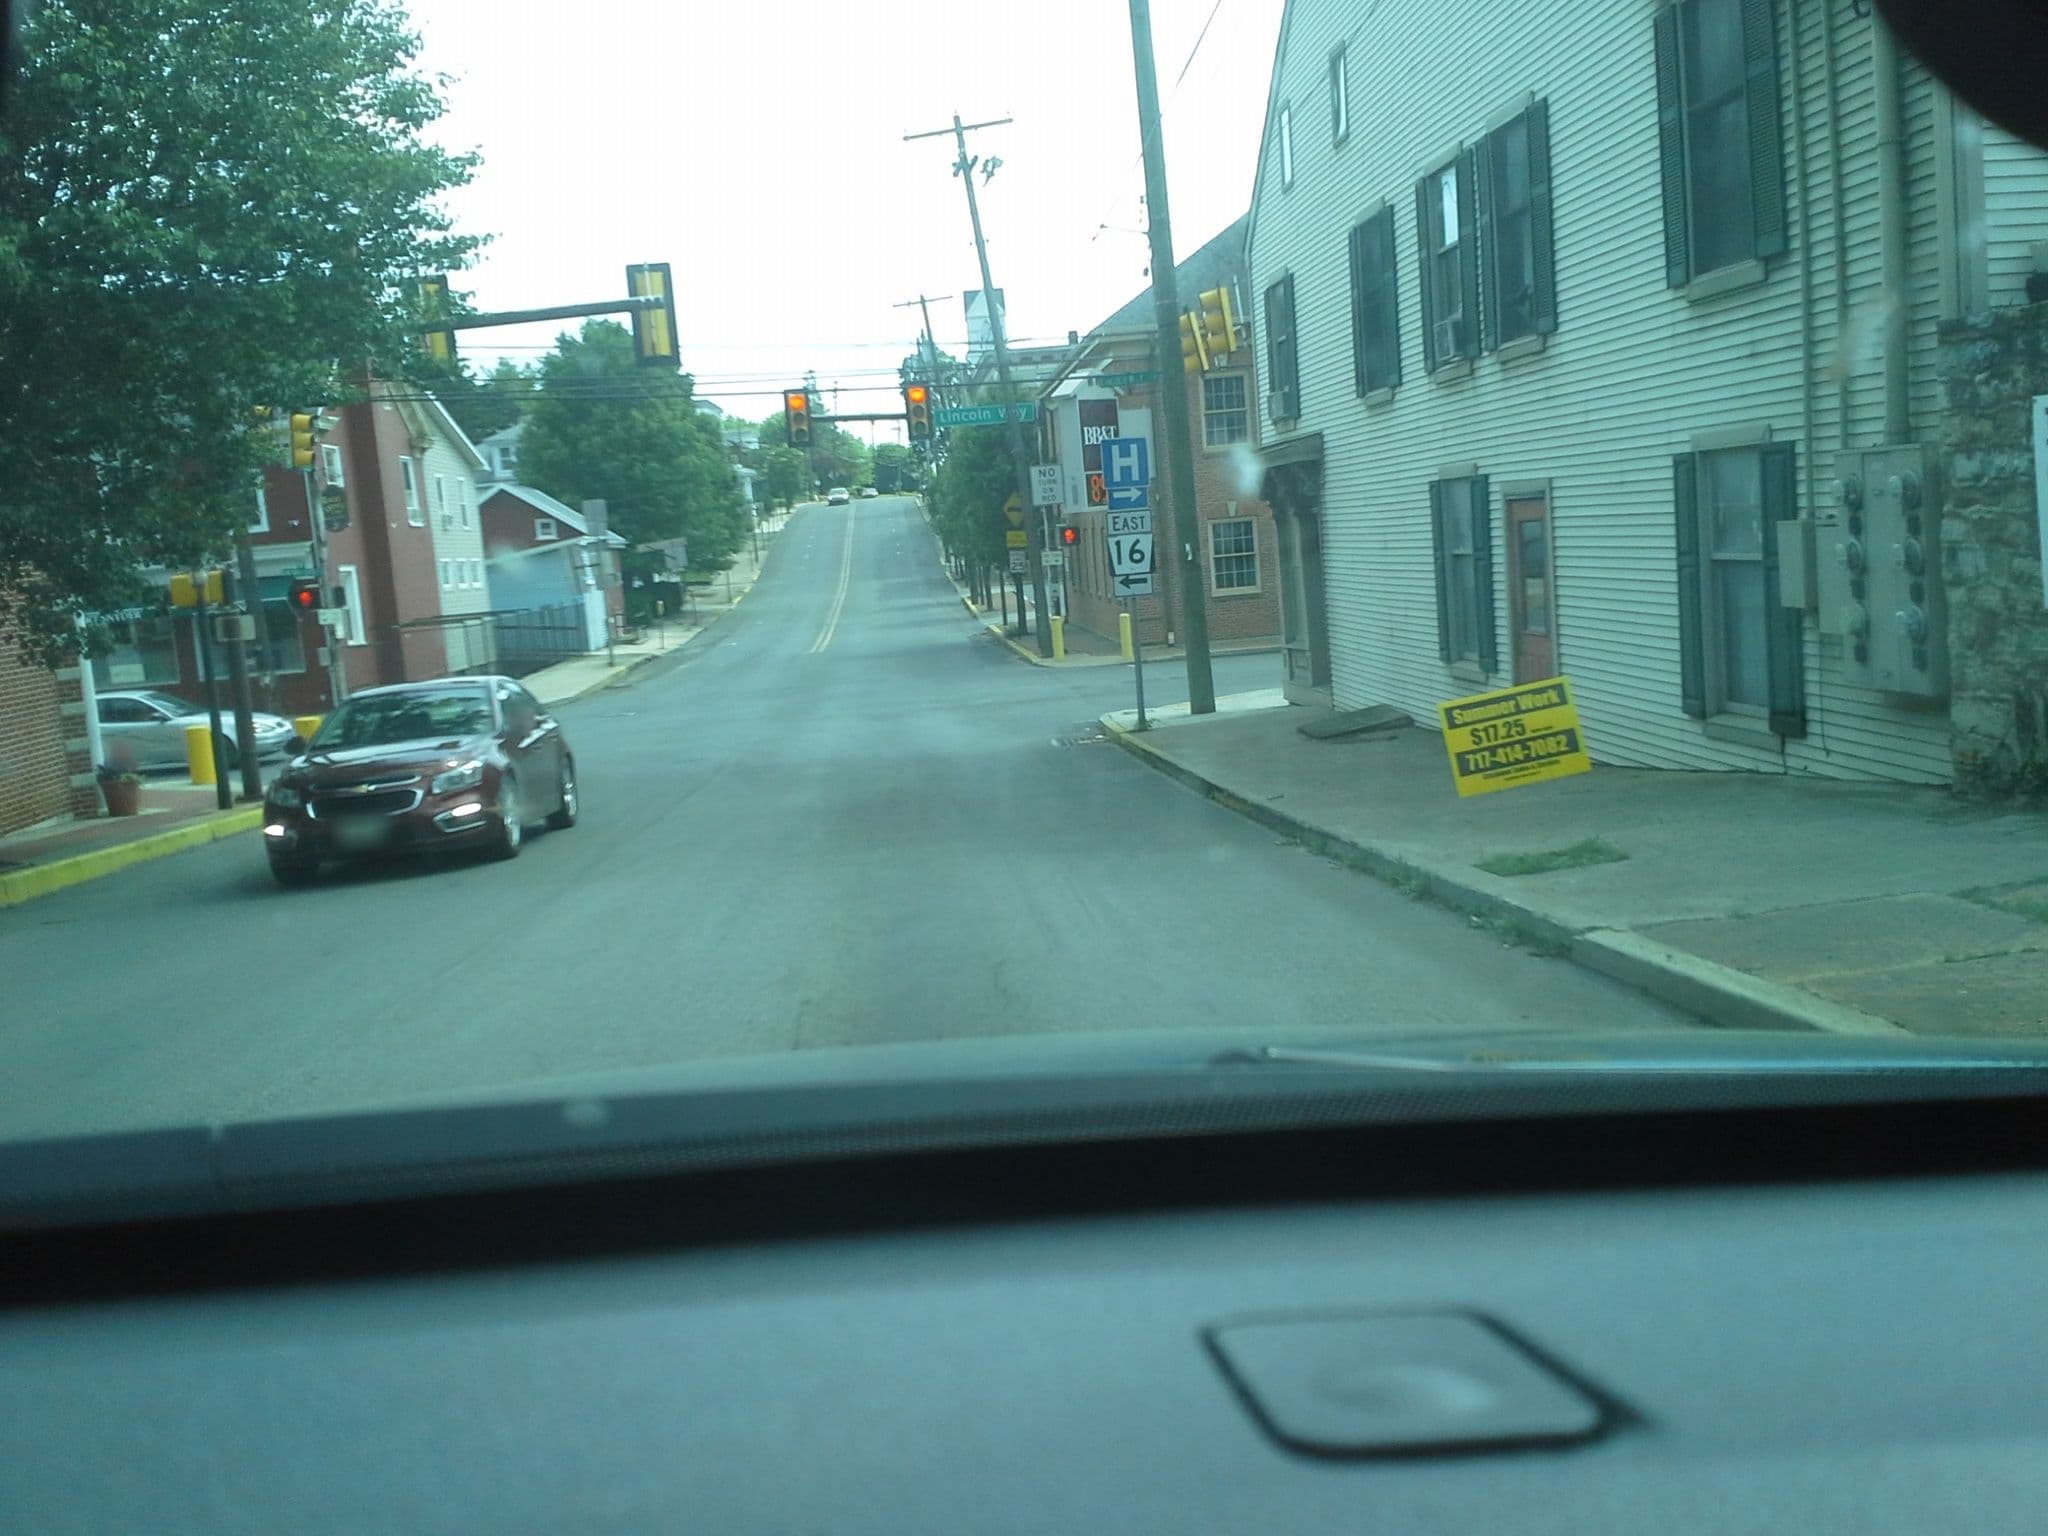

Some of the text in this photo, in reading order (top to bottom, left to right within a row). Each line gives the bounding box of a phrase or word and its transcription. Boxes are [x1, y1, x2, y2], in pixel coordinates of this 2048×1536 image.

[939, 408, 991, 423] Lincoln
[1083, 426, 1117, 445] BB&T
[1038, 468, 1056, 478] NO
[1112, 443, 1140, 483] H
[1112, 515, 1146, 532] EAST
[1113, 538, 1146, 566] 16
[1452, 688, 1560, 724] Summer Work
[1470, 718, 1526, 747] $17.25
